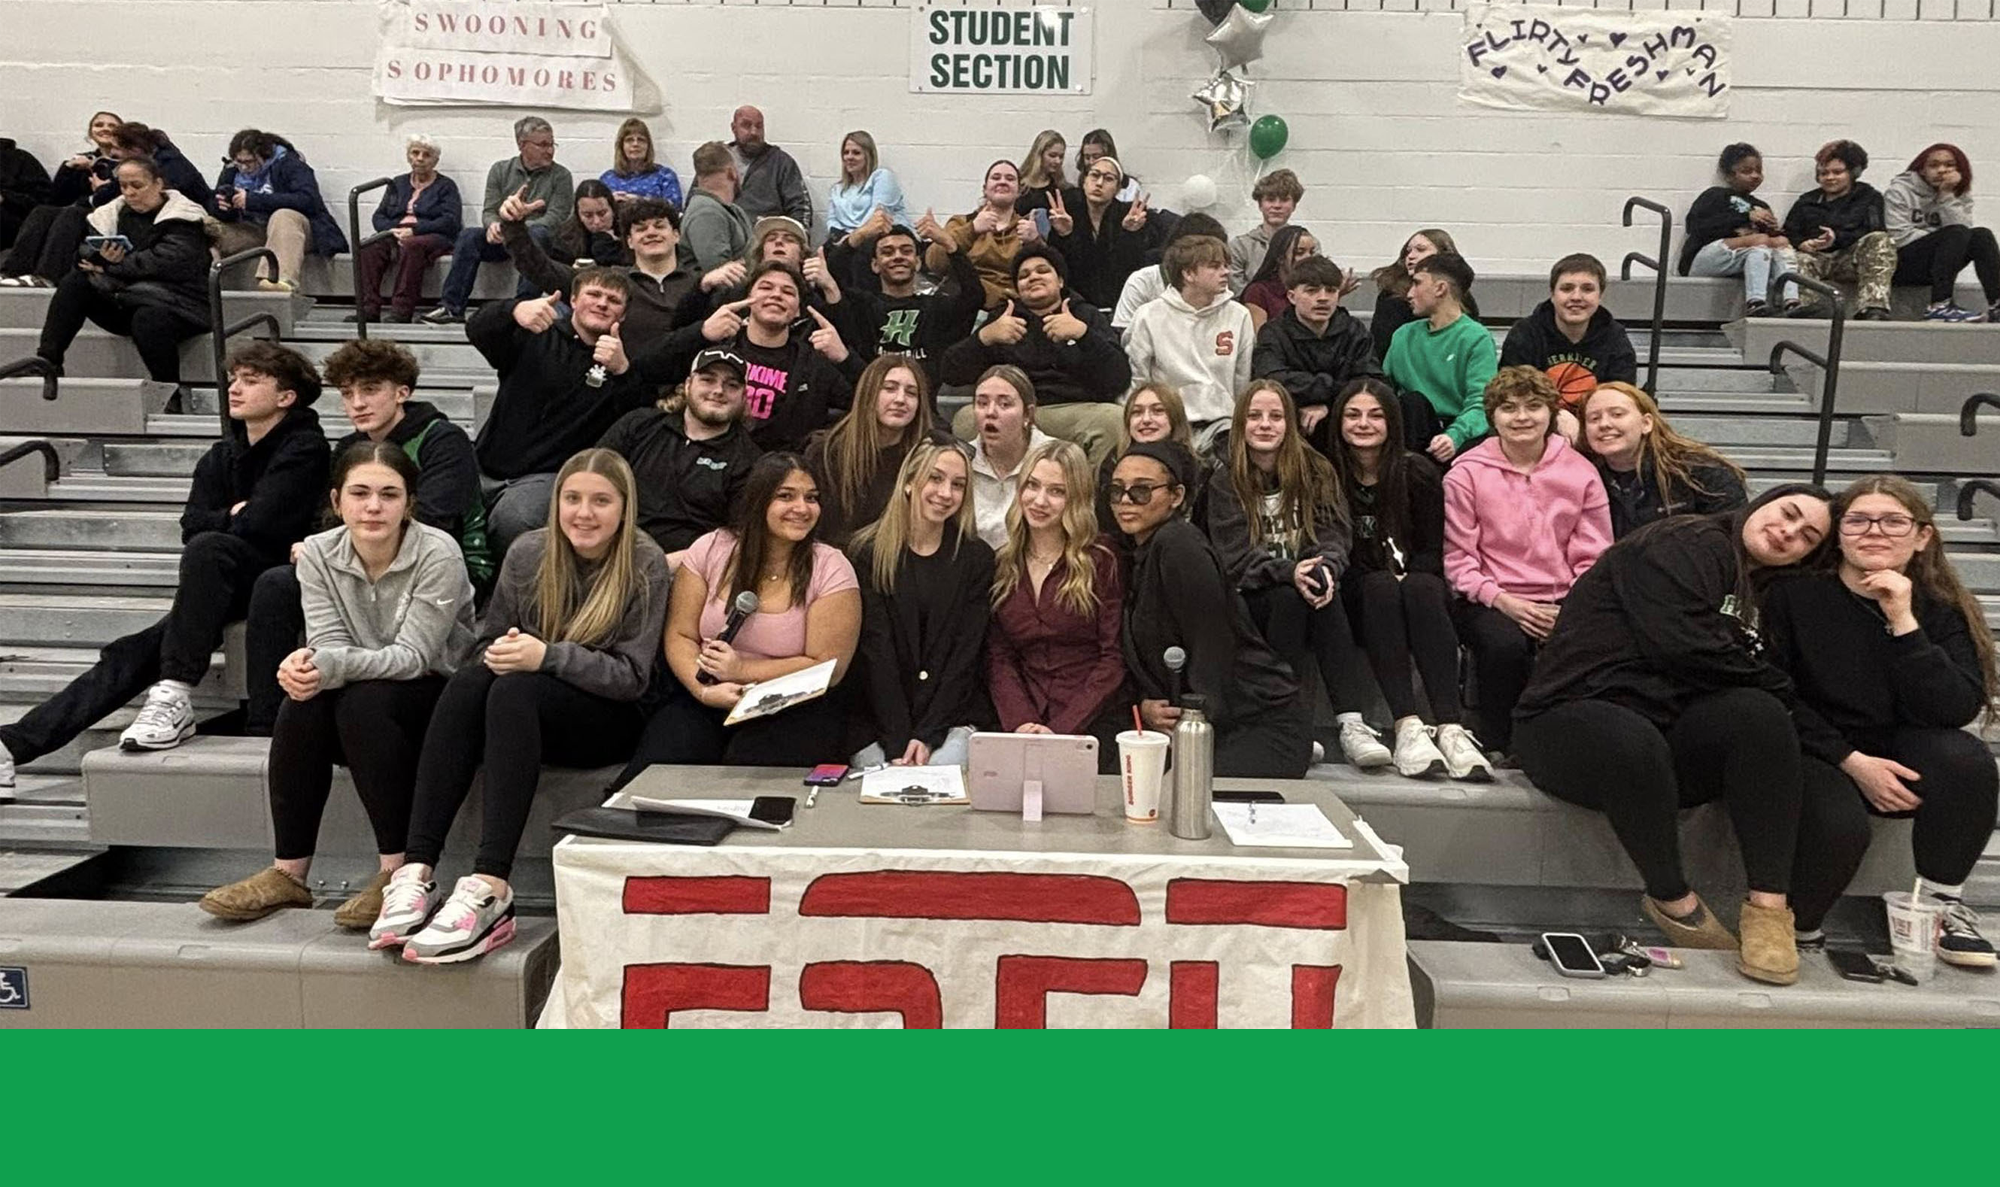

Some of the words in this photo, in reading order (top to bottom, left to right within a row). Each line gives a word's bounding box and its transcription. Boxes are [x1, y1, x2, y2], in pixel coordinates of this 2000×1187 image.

[414, 13, 597, 39] SWOONING
[929, 10, 1075, 46] STUDENT
[387, 60, 617, 92] SOPHOMORES
[930, 53, 1070, 90] SECTION
[1467, 18, 1580, 67] FLIRTY
[1563, 25, 1726, 106] FRESHMAN
[879, 309, 920, 347] H
[1215, 330, 1234, 356] S
